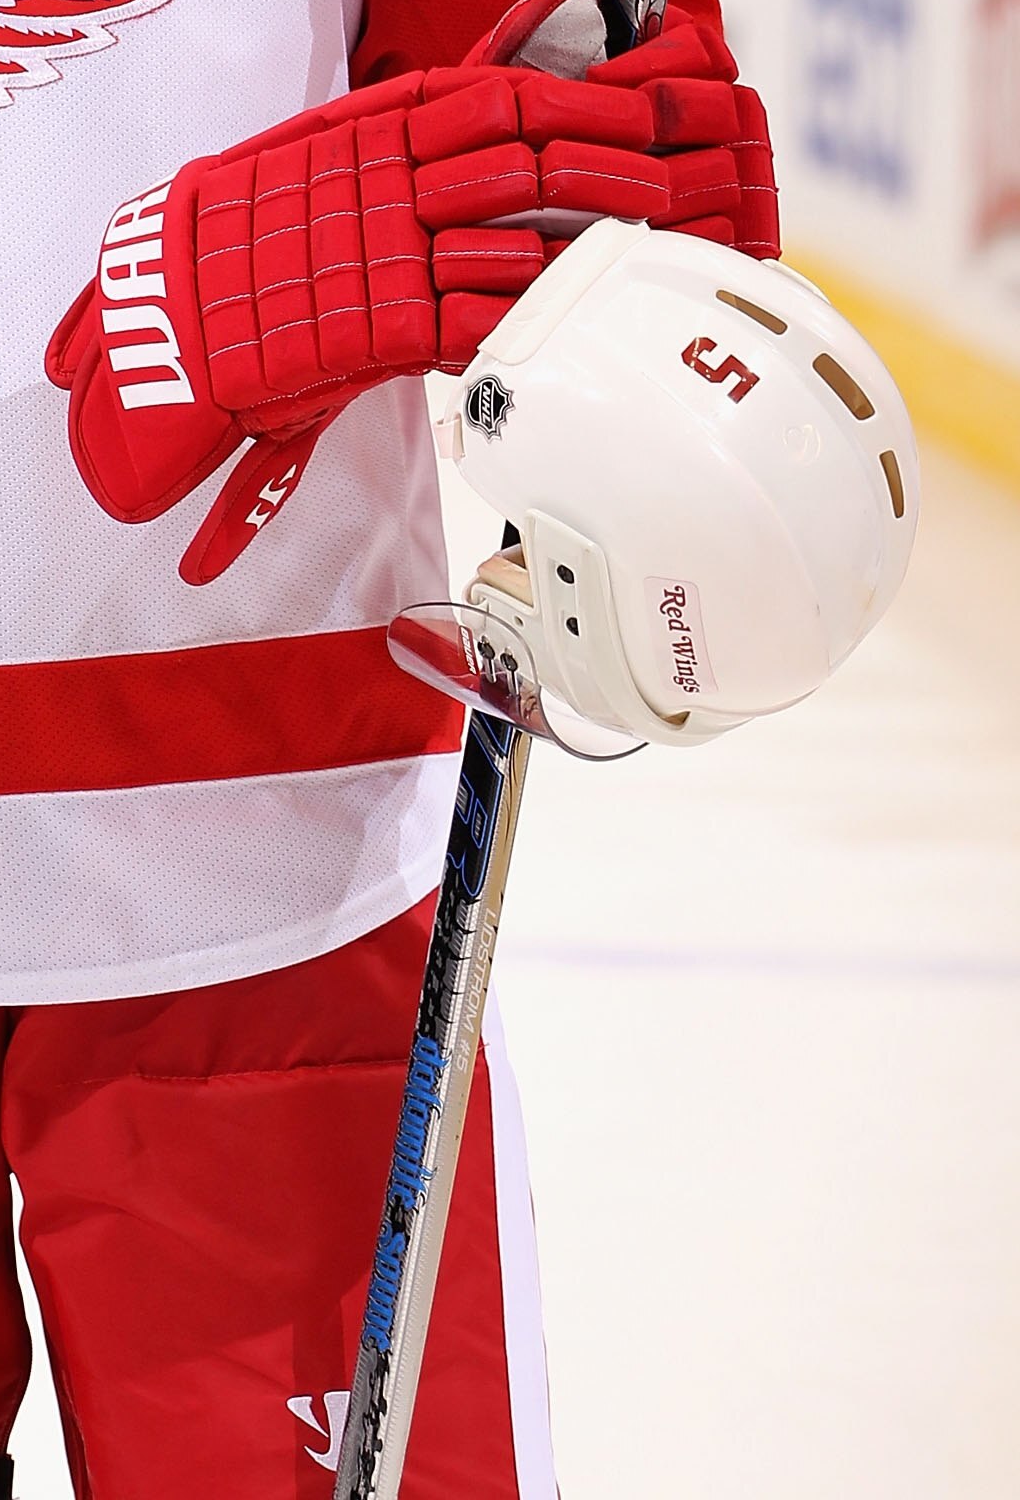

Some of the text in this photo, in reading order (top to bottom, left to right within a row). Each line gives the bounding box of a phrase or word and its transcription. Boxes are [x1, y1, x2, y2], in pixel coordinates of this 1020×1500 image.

[481, 384, 492, 424] NHL
[680, 336, 760, 404] 5
[659, 585, 701, 694] Red Wings
[454, 908, 499, 1076] LIDSTROM #5
